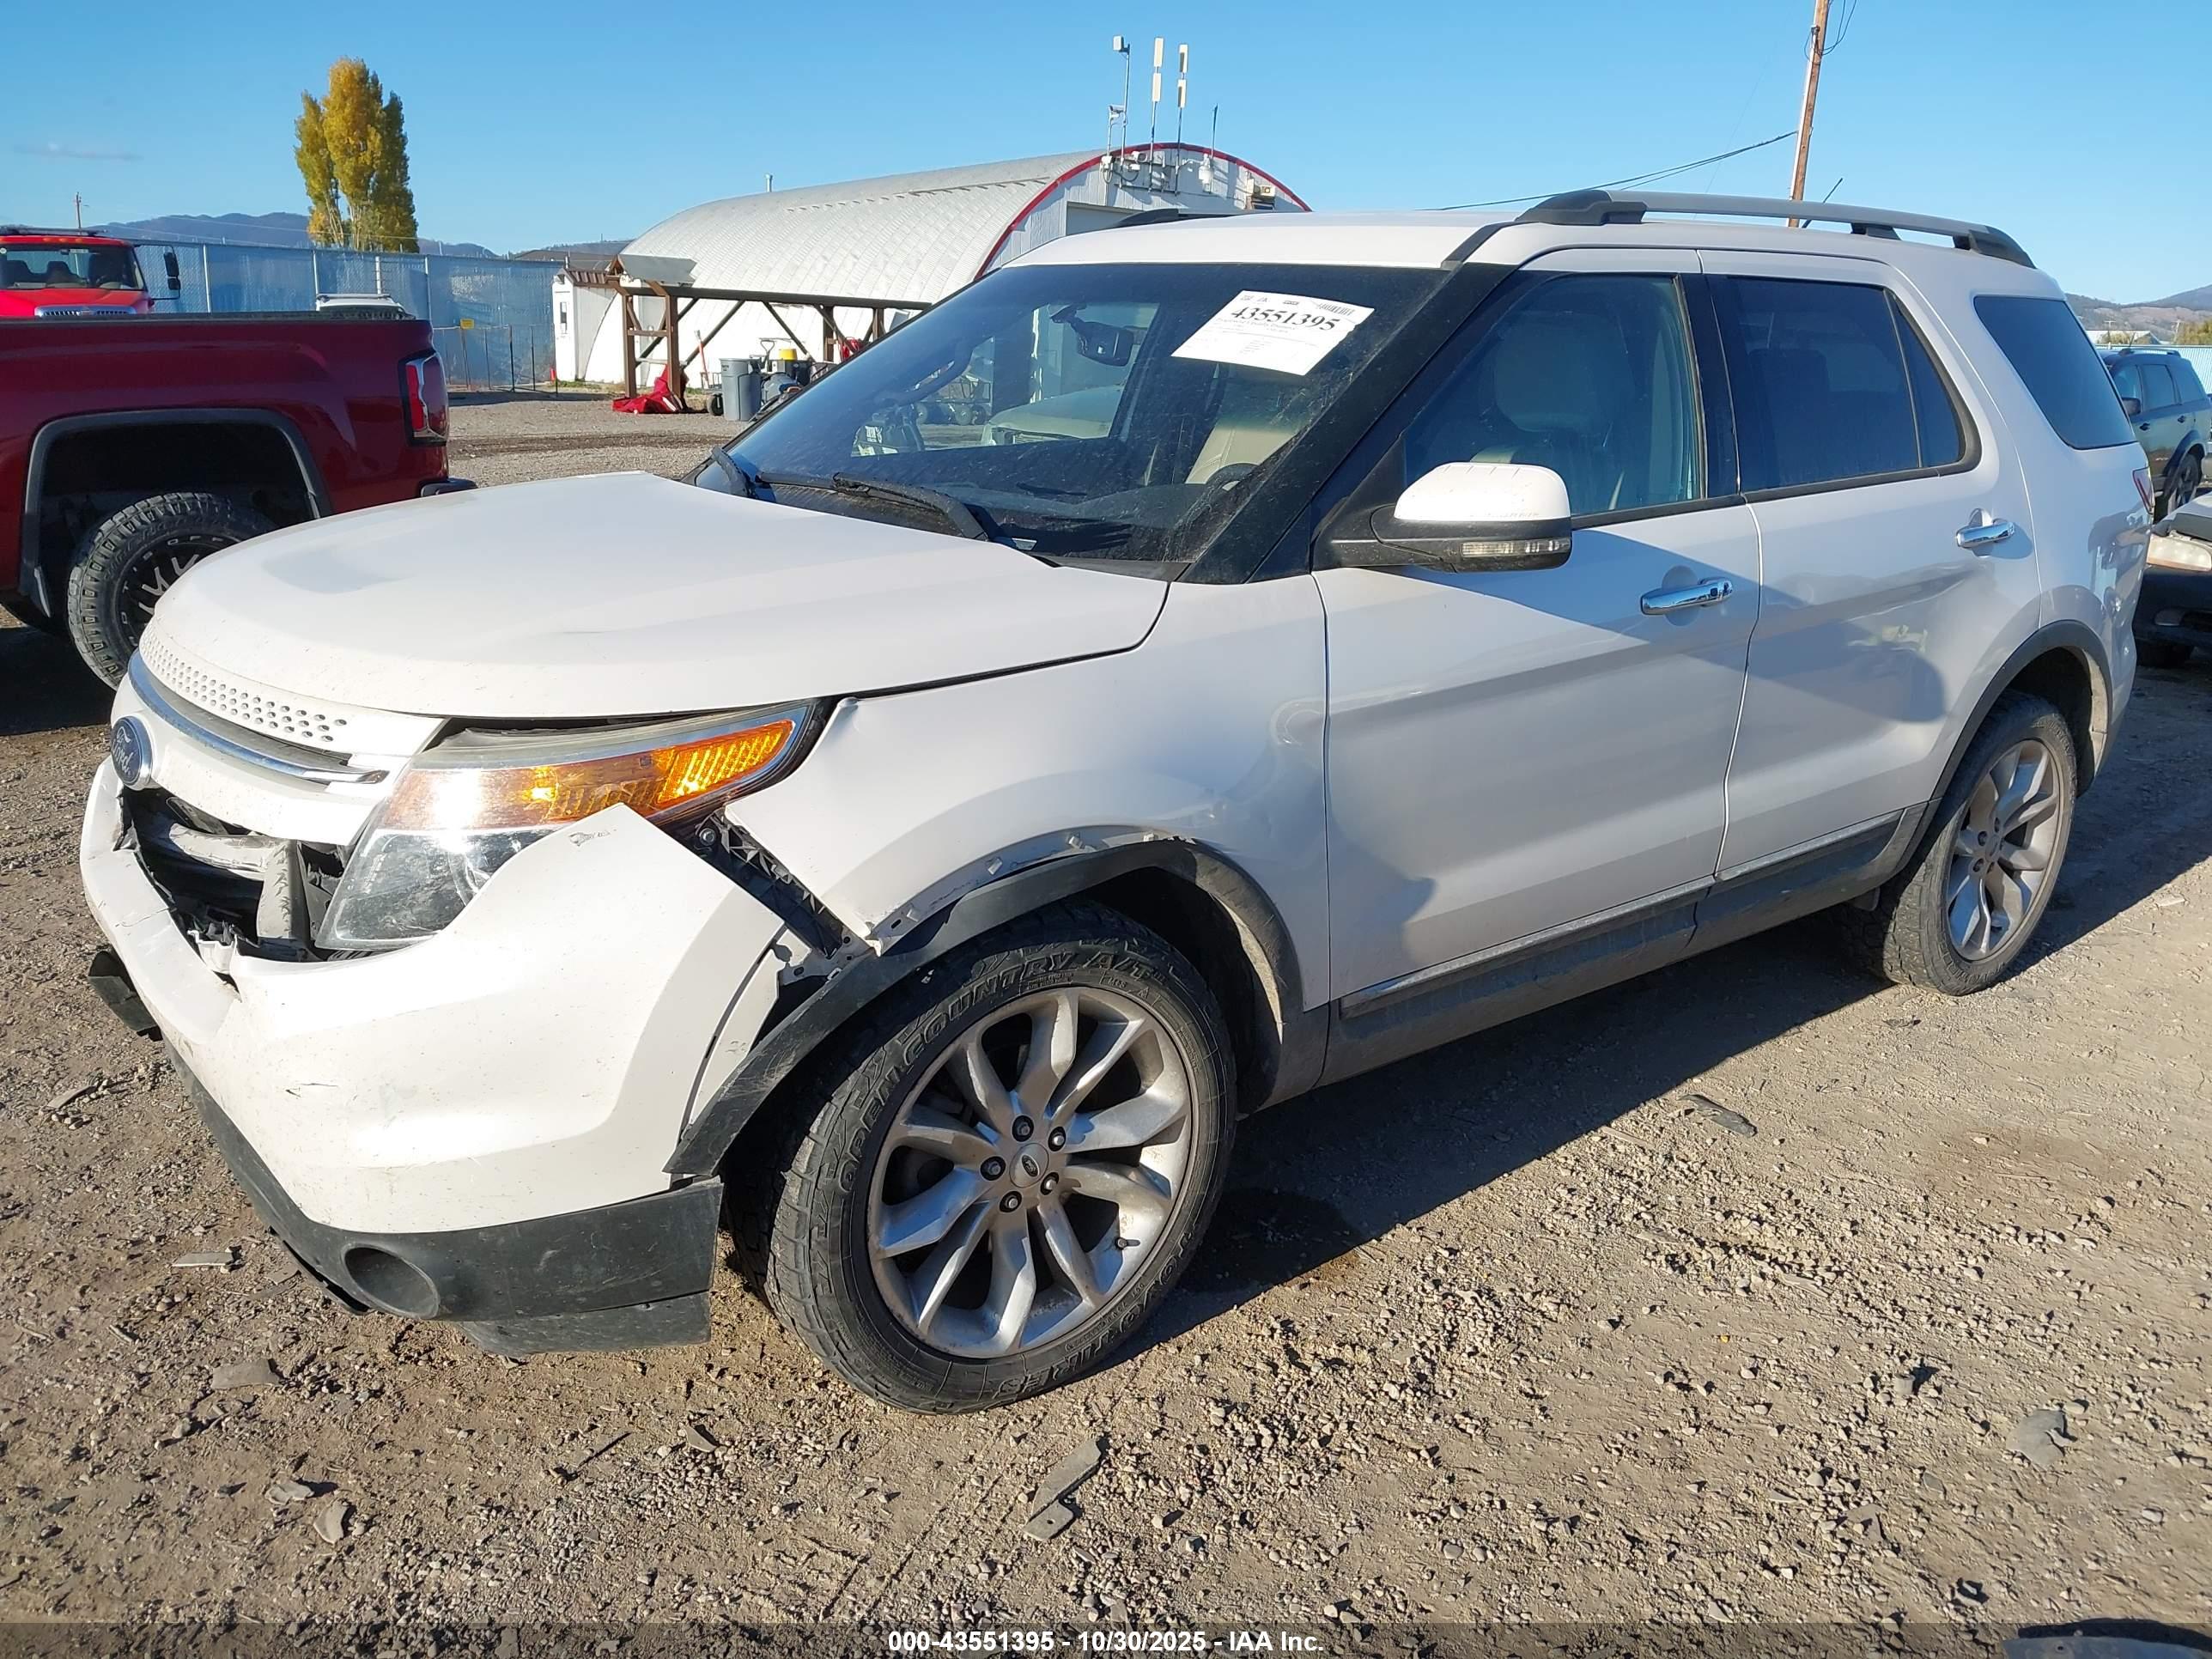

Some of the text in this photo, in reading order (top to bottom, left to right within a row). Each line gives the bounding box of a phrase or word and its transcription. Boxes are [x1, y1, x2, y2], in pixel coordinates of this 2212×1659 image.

[1231, 306, 1340, 331] 43551395
[112, 726, 134, 775] Ford
[839, 1066, 902, 1194] OPEN
[902, 951, 1077, 1067] COUNTRY
